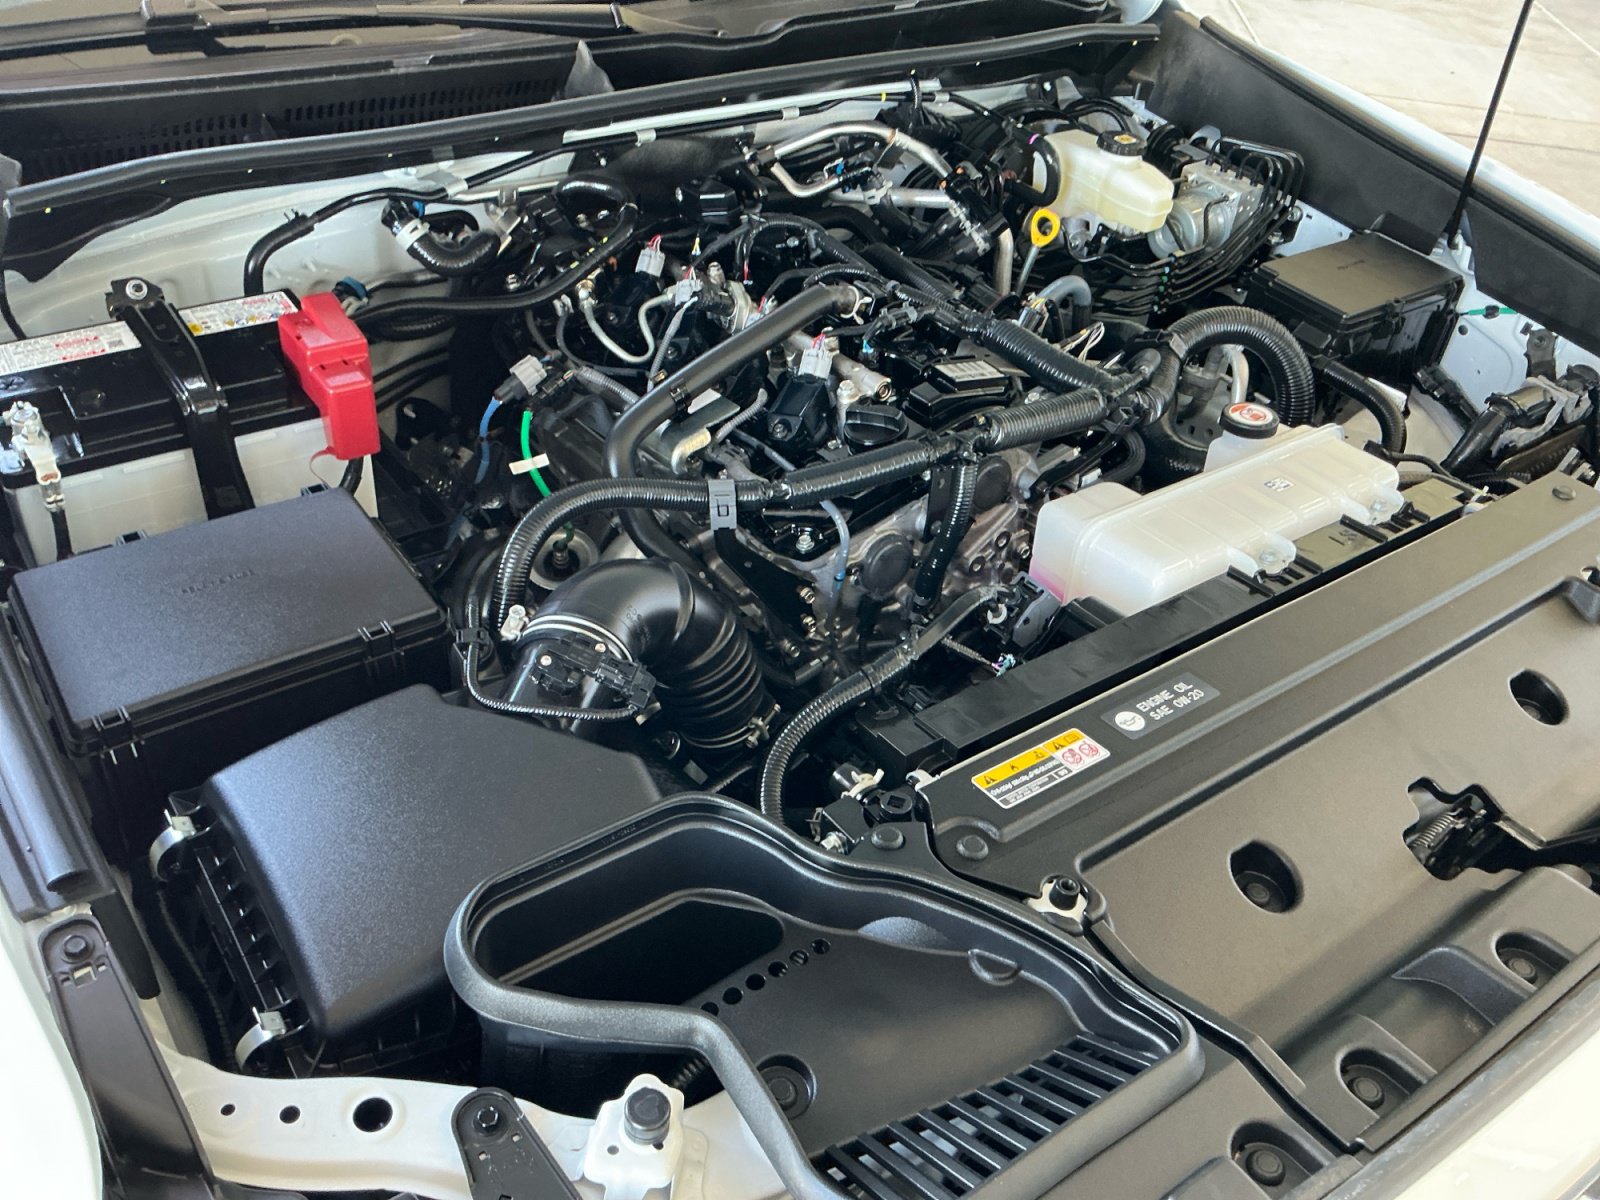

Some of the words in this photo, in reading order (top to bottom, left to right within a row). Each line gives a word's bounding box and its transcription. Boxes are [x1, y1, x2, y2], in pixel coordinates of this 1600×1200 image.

[1136, 690, 1174, 712] ENGINE
[1173, 682, 1193, 692] OIL
[1149, 705, 1174, 720] SAE
[1173, 689, 1204, 707] 0W-20
